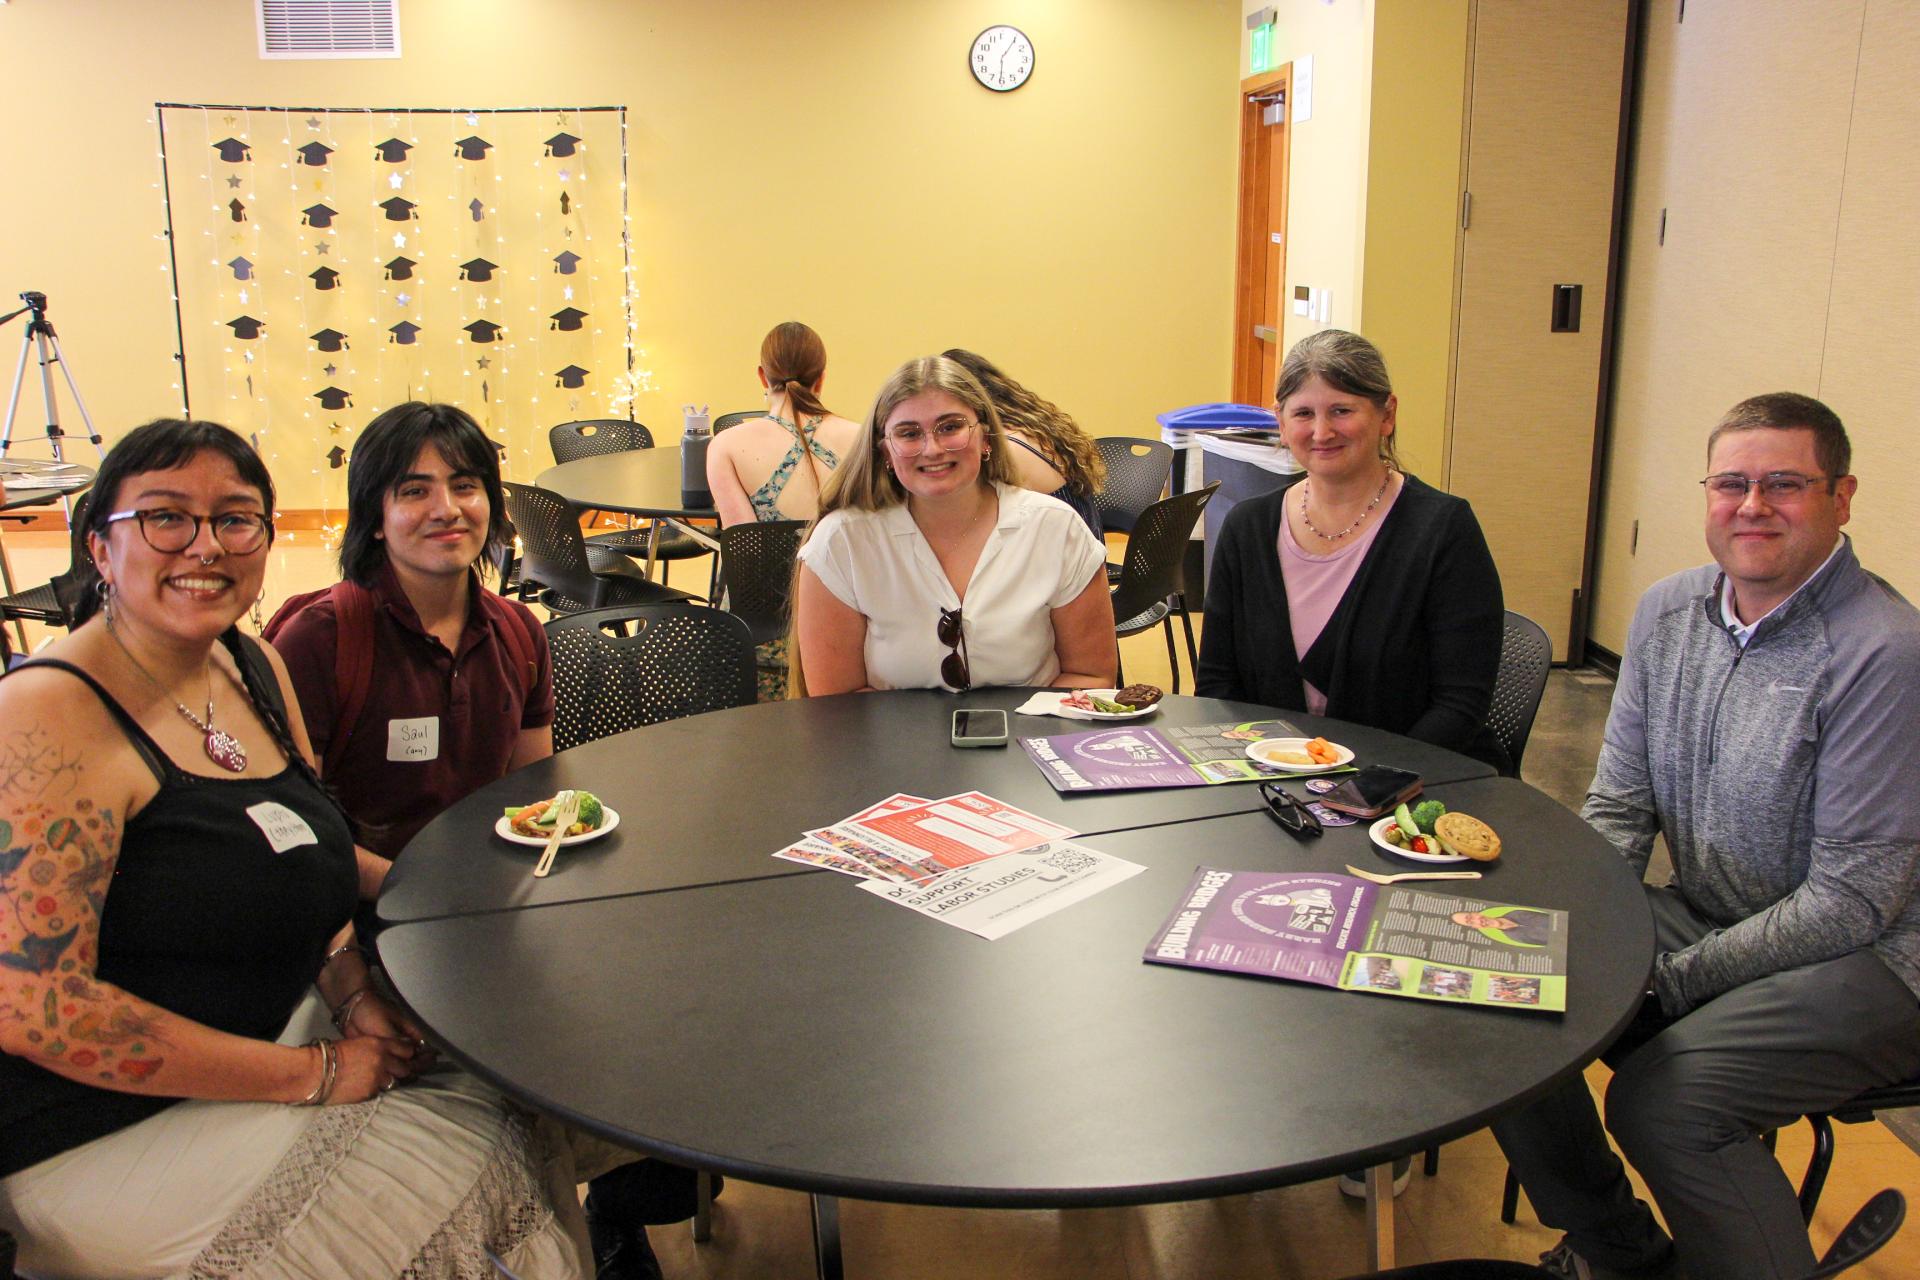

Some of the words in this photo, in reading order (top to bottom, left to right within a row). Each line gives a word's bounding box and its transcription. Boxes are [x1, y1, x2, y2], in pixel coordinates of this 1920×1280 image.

[989, 35, 996, 43] 11
[988, 73, 995, 81] 7
[908, 876, 974, 906] SUPPORT
[927, 891, 978, 914] LABOR
[976, 866, 1036, 893] STUDIES
[1156, 910, 1202, 959] BUILDING
[1186, 870, 1233, 909] BRIDGES
